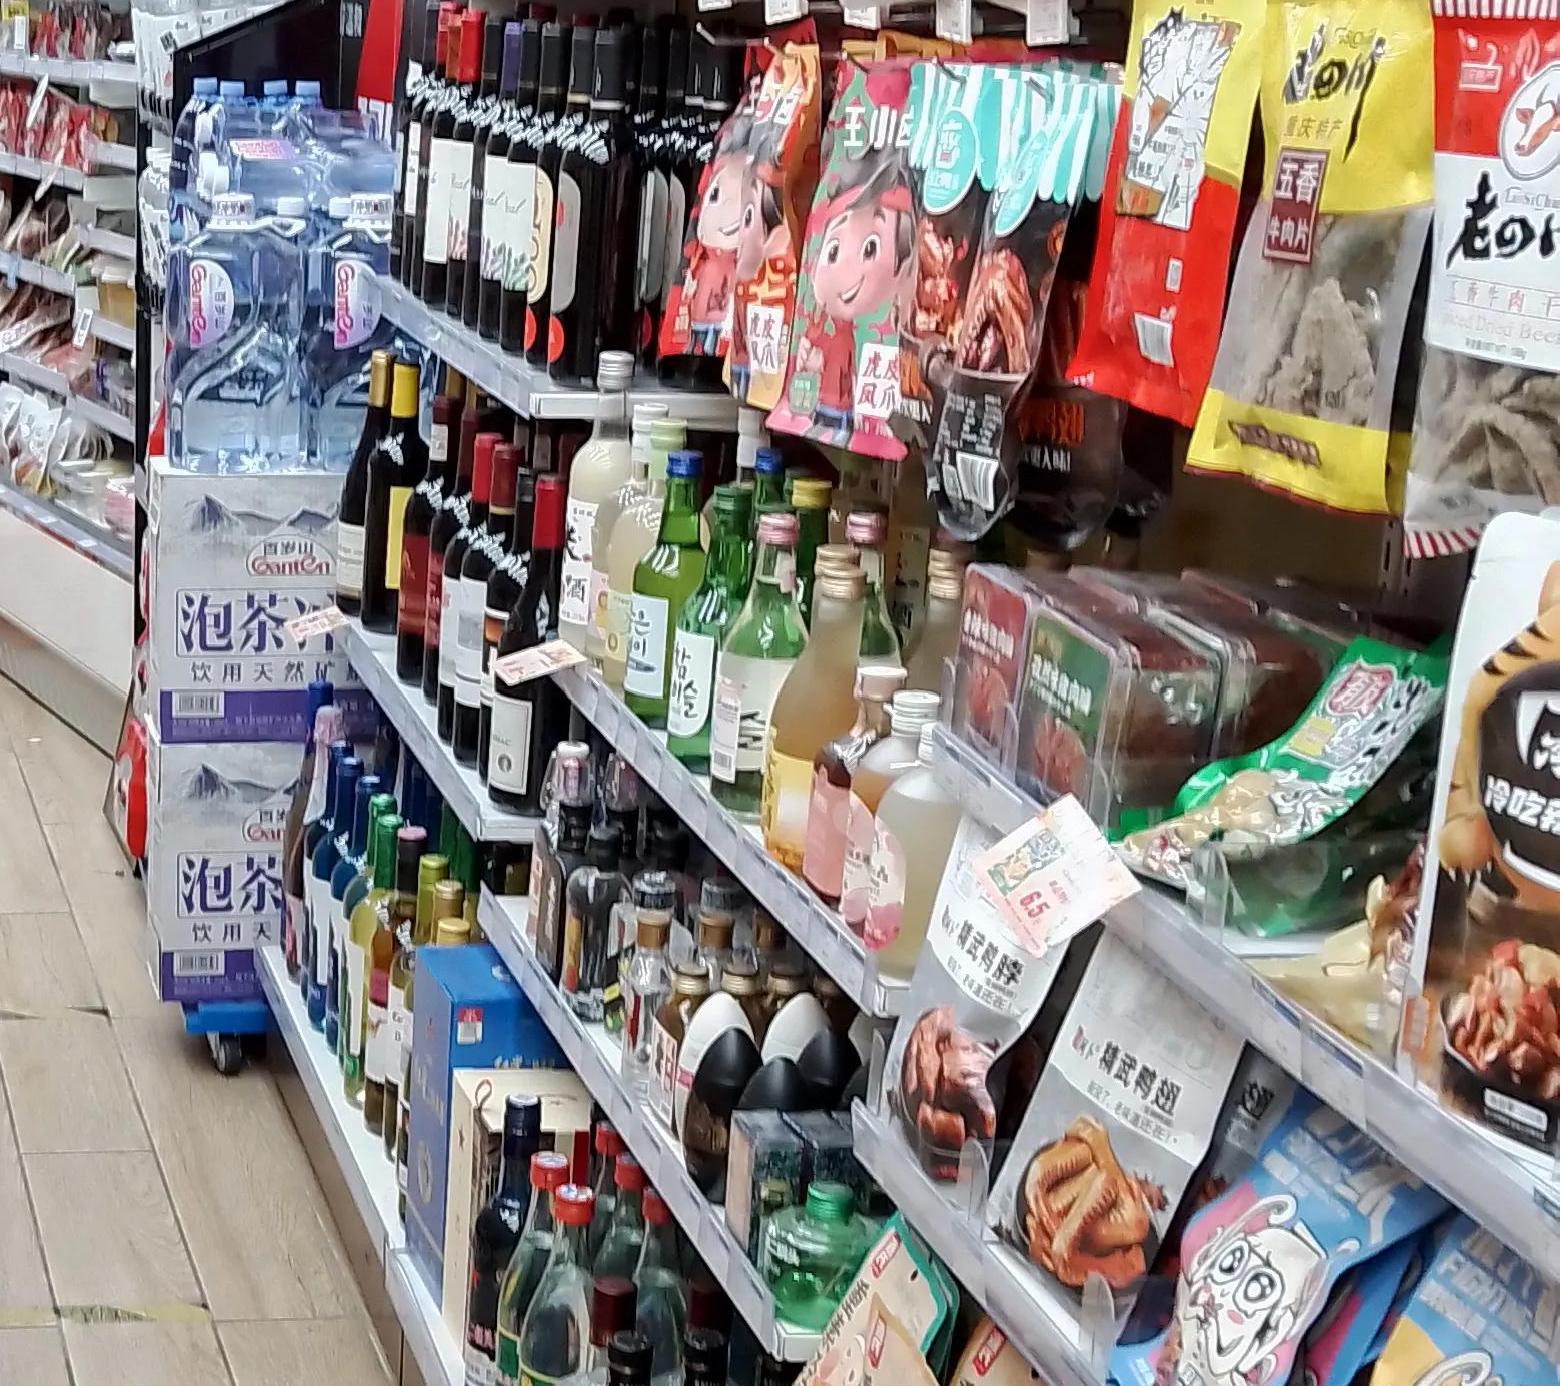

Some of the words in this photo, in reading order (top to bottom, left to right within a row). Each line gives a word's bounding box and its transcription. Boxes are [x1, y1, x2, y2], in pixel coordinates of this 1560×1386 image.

[1274, 162, 1319, 205] 五香
[181, 854, 282, 915] 泡茶
[191, 921, 272, 943] 饮用天
[1099, 1038, 1183, 1115] 精武鸭翅
